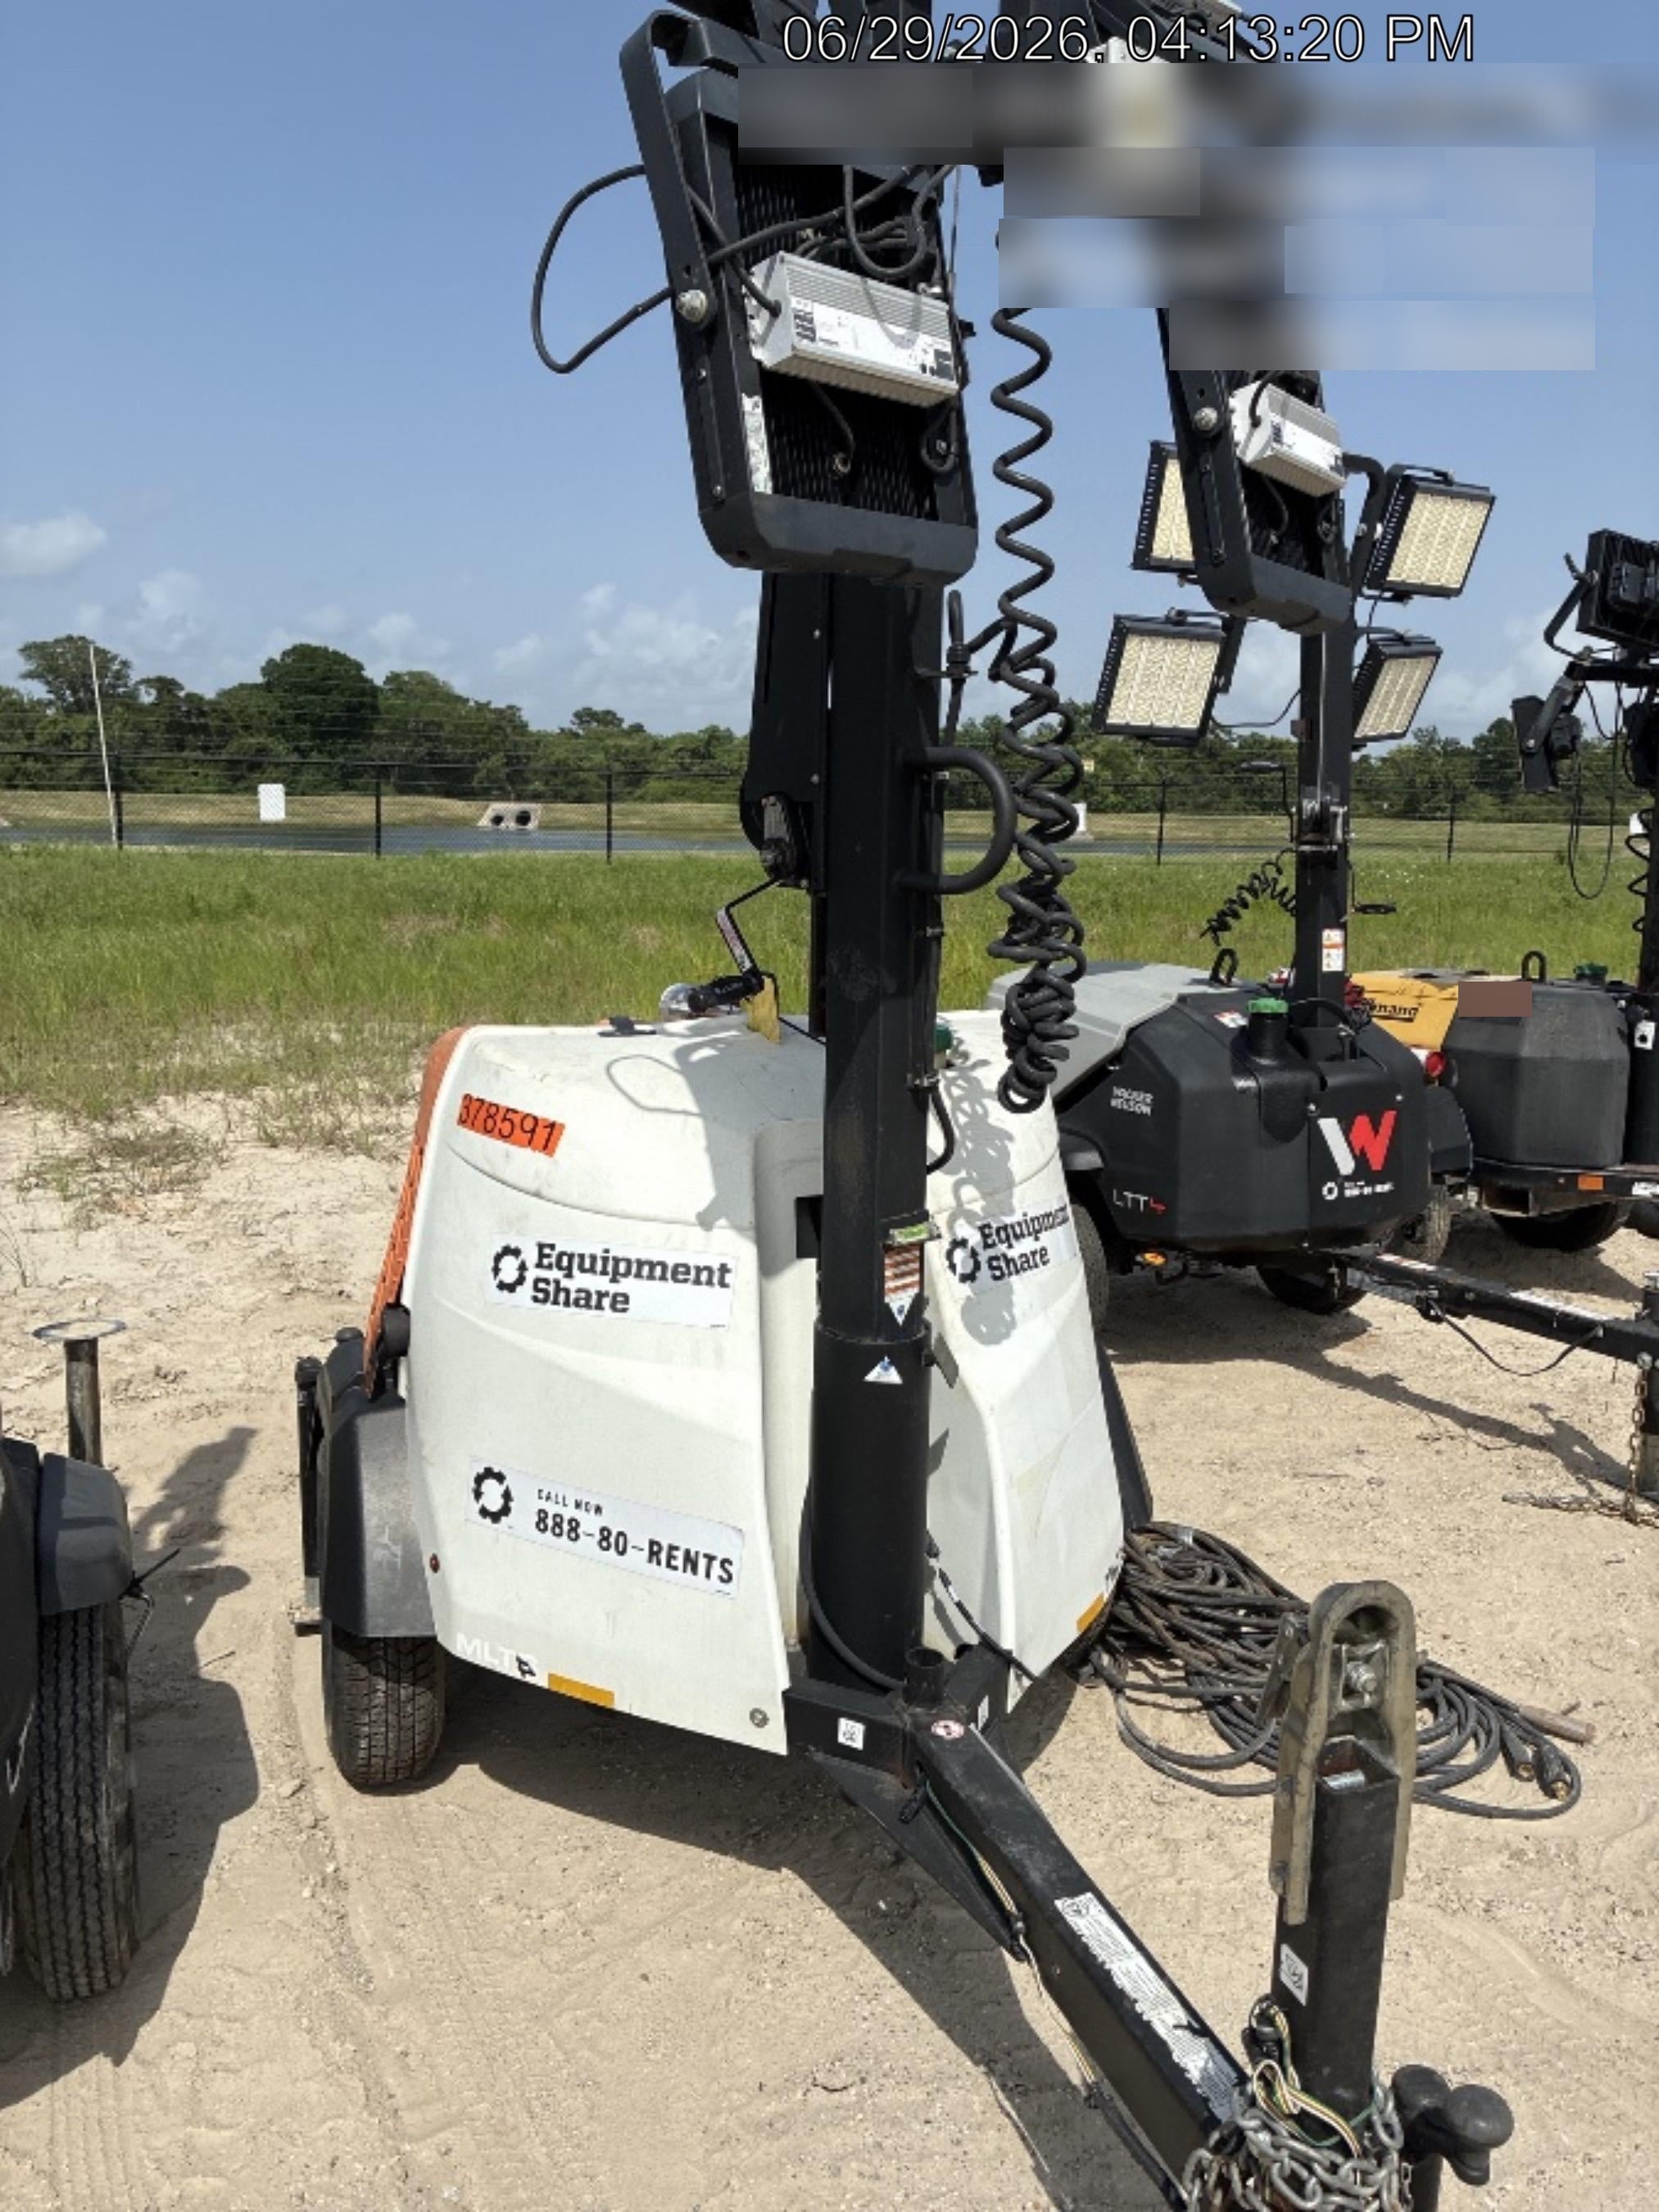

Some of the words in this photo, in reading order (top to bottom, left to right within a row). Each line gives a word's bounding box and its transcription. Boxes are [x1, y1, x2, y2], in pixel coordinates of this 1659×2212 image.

[978, 1203, 1070, 1251] Equipm
[534, 1241, 732, 1288] Equipment
[987, 1246, 1050, 1281] Share
[531, 1276, 630, 1313] Share
[537, 1489, 569, 1507] CALL
[574, 1498, 604, 1516] NOW
[535, 1508, 734, 1584] 888-80-RENTS
